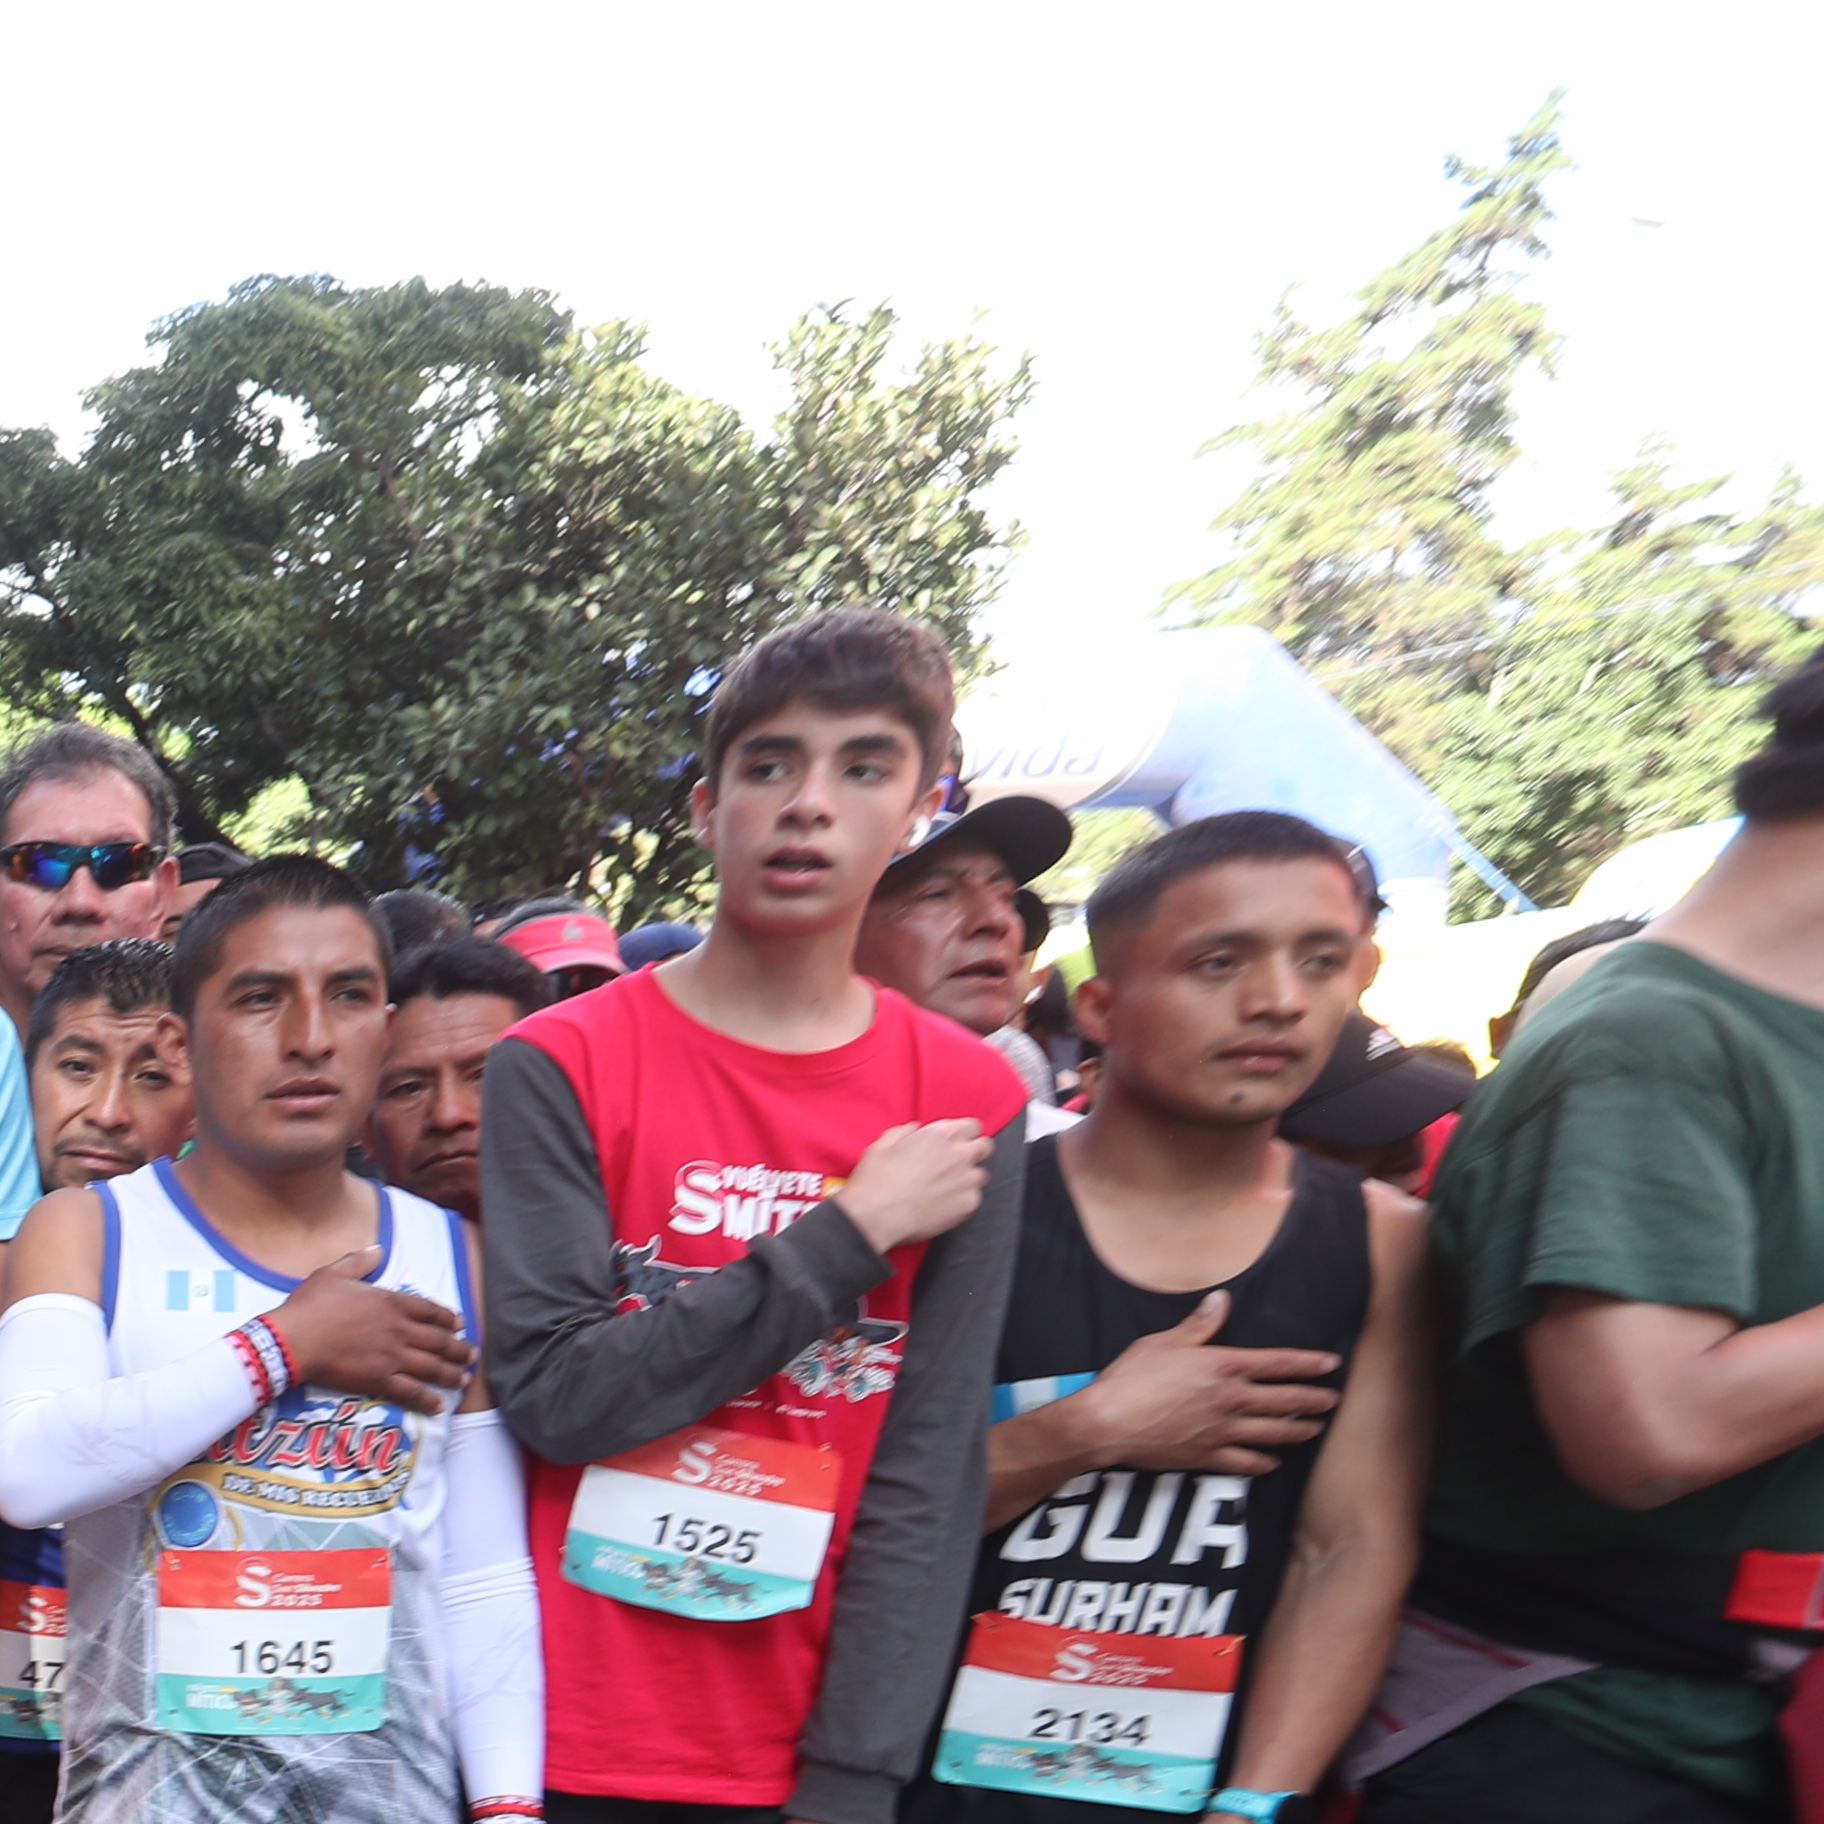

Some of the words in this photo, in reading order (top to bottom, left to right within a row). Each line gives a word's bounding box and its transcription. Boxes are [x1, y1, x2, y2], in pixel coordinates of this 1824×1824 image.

[651, 1512, 765, 1565] 1525
[998, 1470, 1253, 1571] GUA
[997, 1577, 1240, 1639] SURHAM
[229, 1638, 337, 1676] 1645
[1028, 1707, 1154, 1748] 2134
